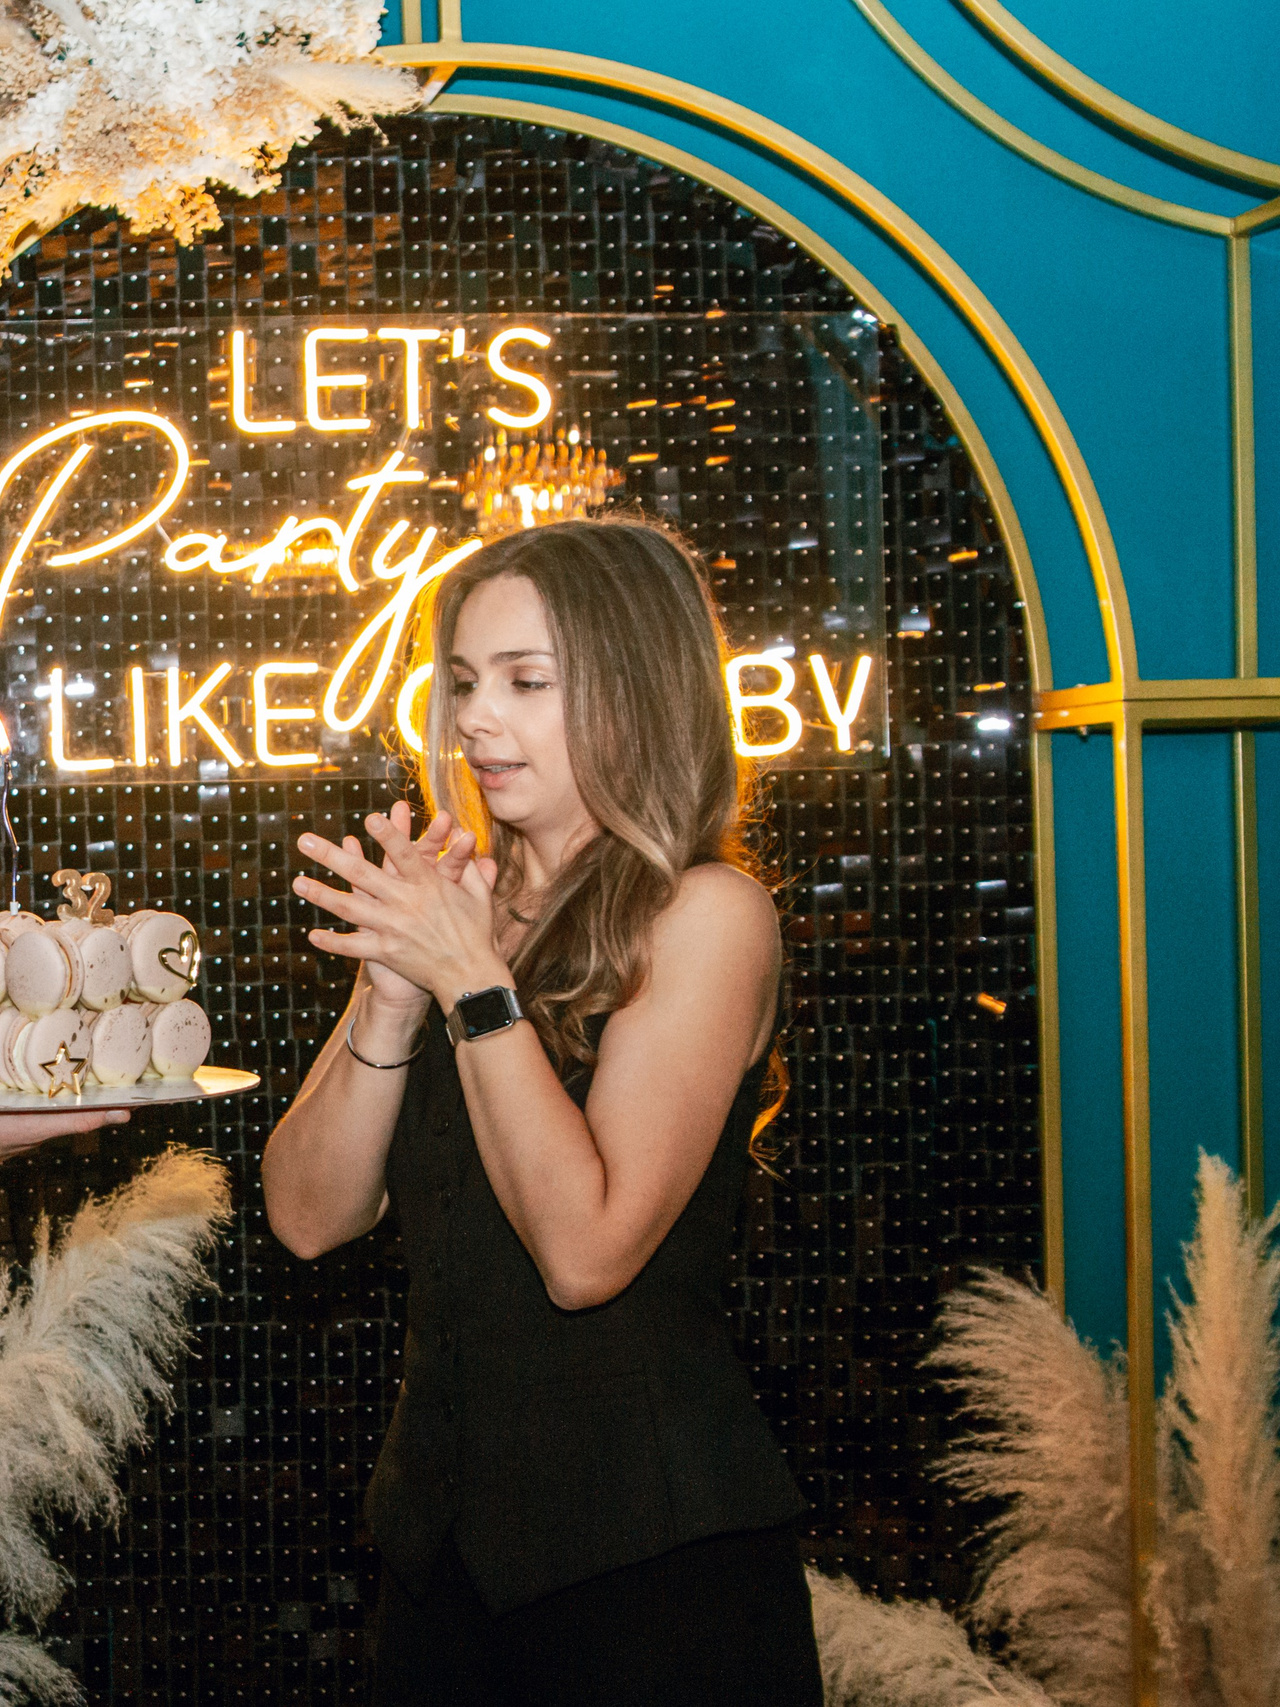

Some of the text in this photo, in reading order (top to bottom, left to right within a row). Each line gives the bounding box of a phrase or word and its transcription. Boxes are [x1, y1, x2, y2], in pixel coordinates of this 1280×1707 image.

[231, 326, 553, 434] LET'S
[49, 660, 320, 772] LIKE
[51, 868, 115, 925] 32
